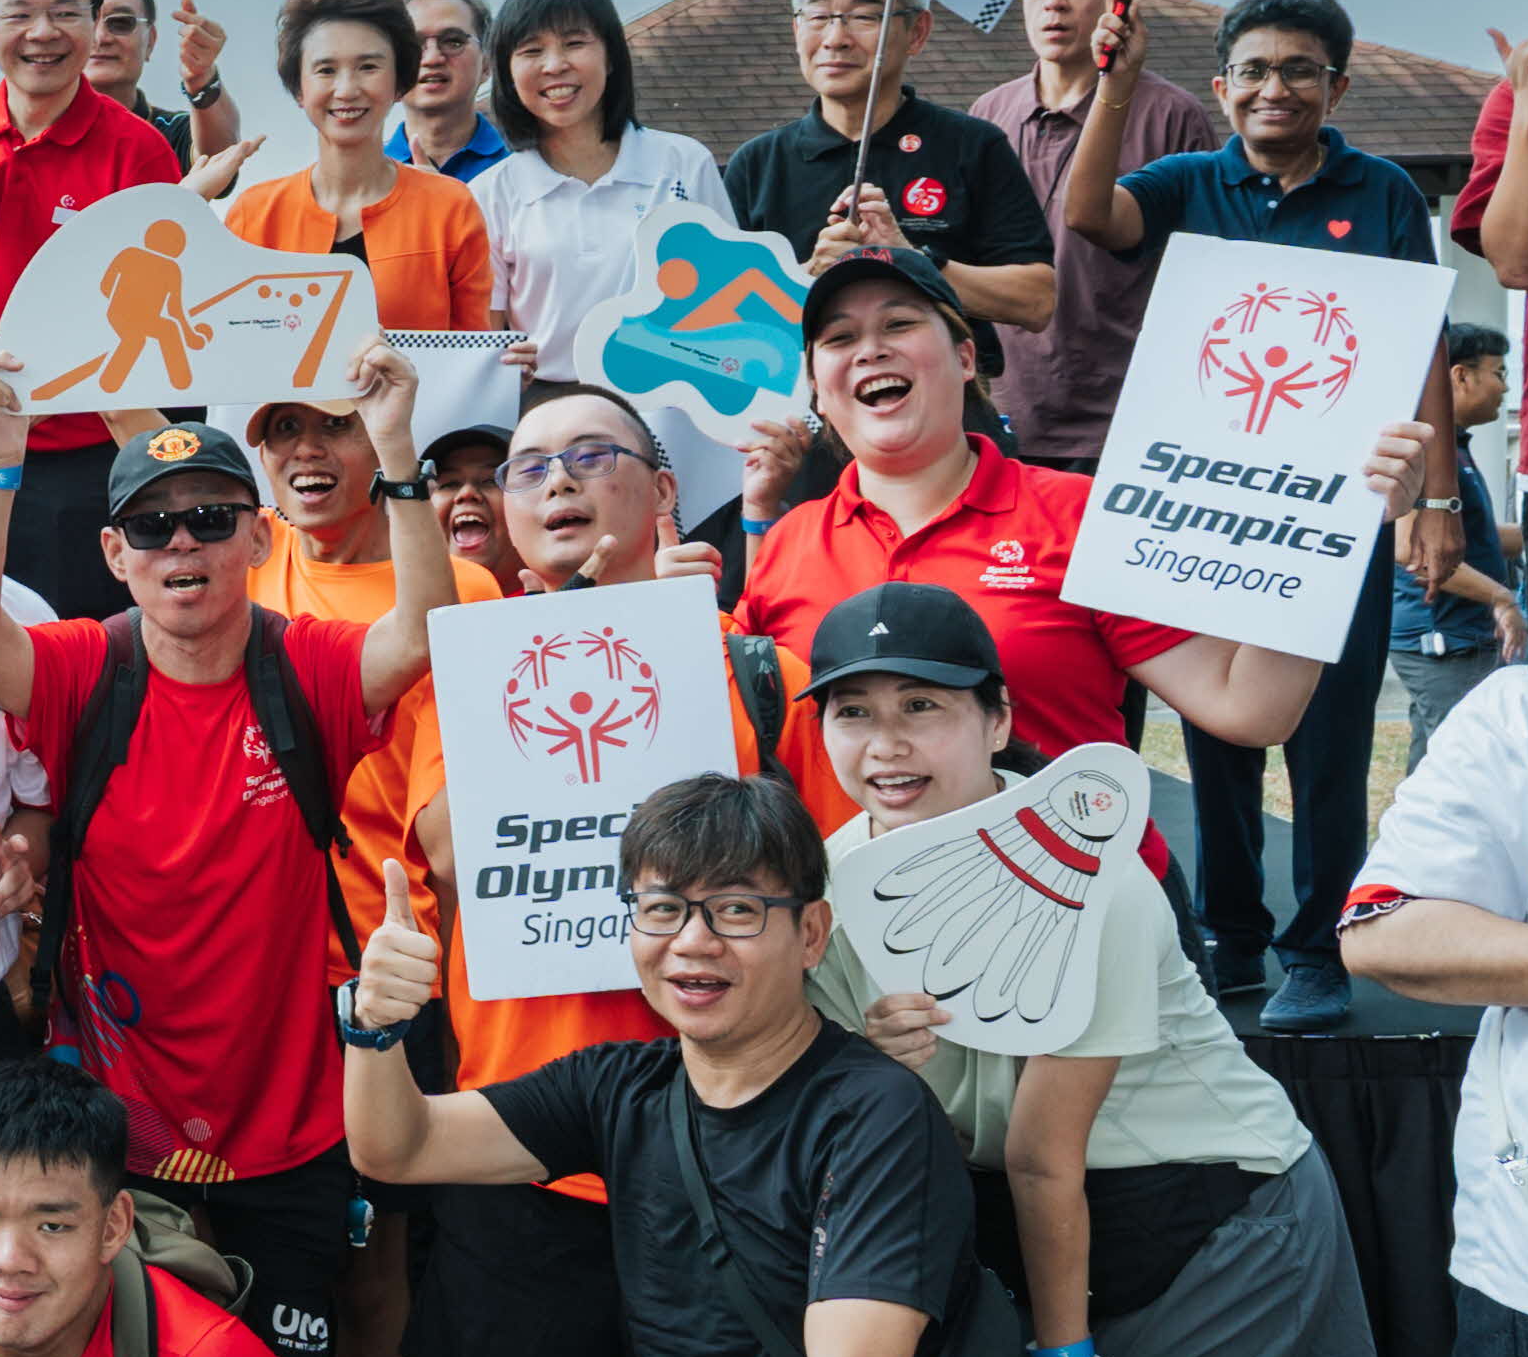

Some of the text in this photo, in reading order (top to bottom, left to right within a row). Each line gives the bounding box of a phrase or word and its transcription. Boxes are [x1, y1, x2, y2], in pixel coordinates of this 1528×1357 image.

[1140, 441, 1347, 505] Special
[1102, 483, 1357, 558] Olympics
[1125, 538, 1301, 599] Singapore
[496, 803, 643, 854] Spec
